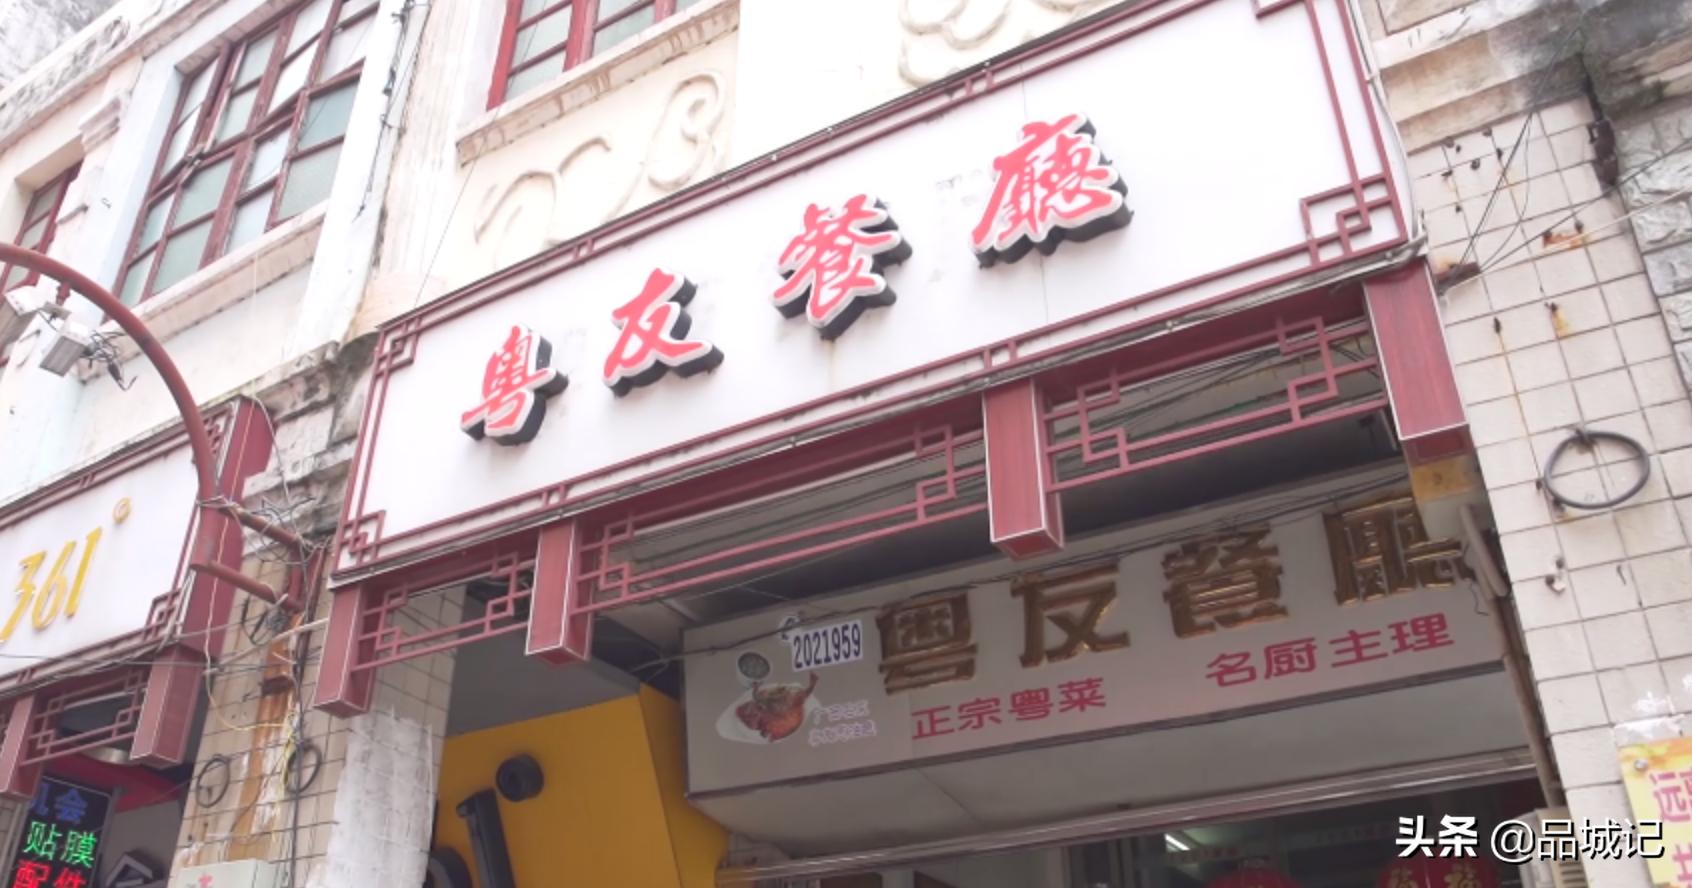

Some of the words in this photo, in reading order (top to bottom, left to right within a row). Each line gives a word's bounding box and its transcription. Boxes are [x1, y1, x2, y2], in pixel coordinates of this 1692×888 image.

[792, 623, 861, 669] 2021959
[1205, 612, 1455, 688] 名厨主理
[911, 677, 1107, 740] 正宗粤菜
[23, 821, 98, 869] 贴膜
